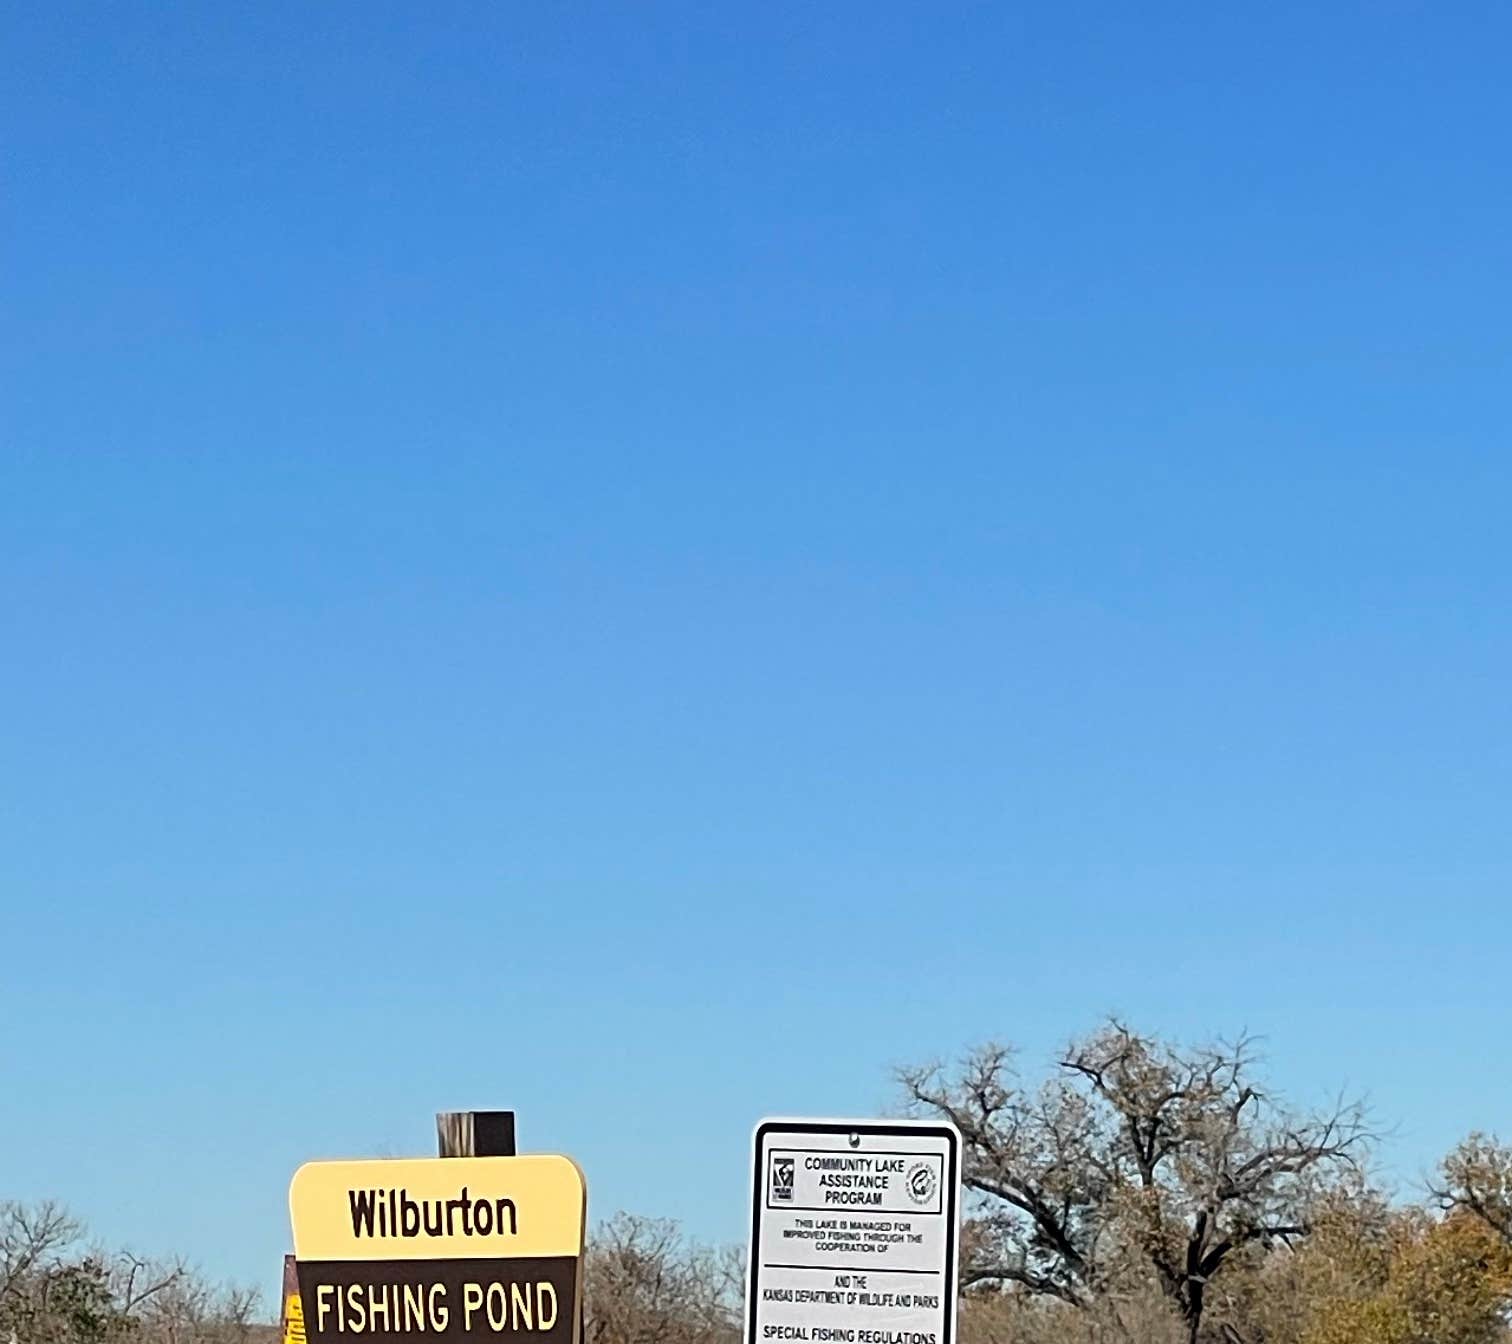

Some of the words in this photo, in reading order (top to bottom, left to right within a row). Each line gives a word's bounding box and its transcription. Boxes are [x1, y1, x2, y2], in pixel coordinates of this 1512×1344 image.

[804, 1157, 873, 1172] COMMUNITY
[875, 1159, 905, 1173] LAKE
[819, 1174, 889, 1189] ASSISTANCE
[825, 1191, 883, 1206] PROGRAM
[348, 1186, 518, 1239] Wilburton
[795, 1218, 813, 1229] THIS
[815, 1219, 837, 1230] LAKE
[839, 1220, 848, 1230] IS
[850, 1221, 891, 1232] MANAGED
[894, 1223, 911, 1232] FOR
[783, 1230, 826, 1240] IMPROVED
[828, 1231, 861, 1241] FISHING
[864, 1233, 904, 1243] THROUGH
[907, 1234, 923, 1244] THE
[815, 1241, 875, 1252] COOPERATION
[877, 1244, 889, 1253] OF
[834, 1275, 851, 1289] AND
[852, 1276, 867, 1289] THE
[763, 1289, 793, 1302] KANSAS
[795, 1290, 844, 1304] DEPARTMENT
[846, 1292, 857, 1305] OF
[858, 1294, 894, 1307] WILDLIFE
[895, 1295, 910, 1307] AND
[913, 1296, 939, 1309] PARKS
[316, 1282, 449, 1334] FISHING
[463, 1281, 558, 1332] POND
[763, 1325, 809, 1340] SPECIAL
[811, 1327, 855, 1343] FISHING
